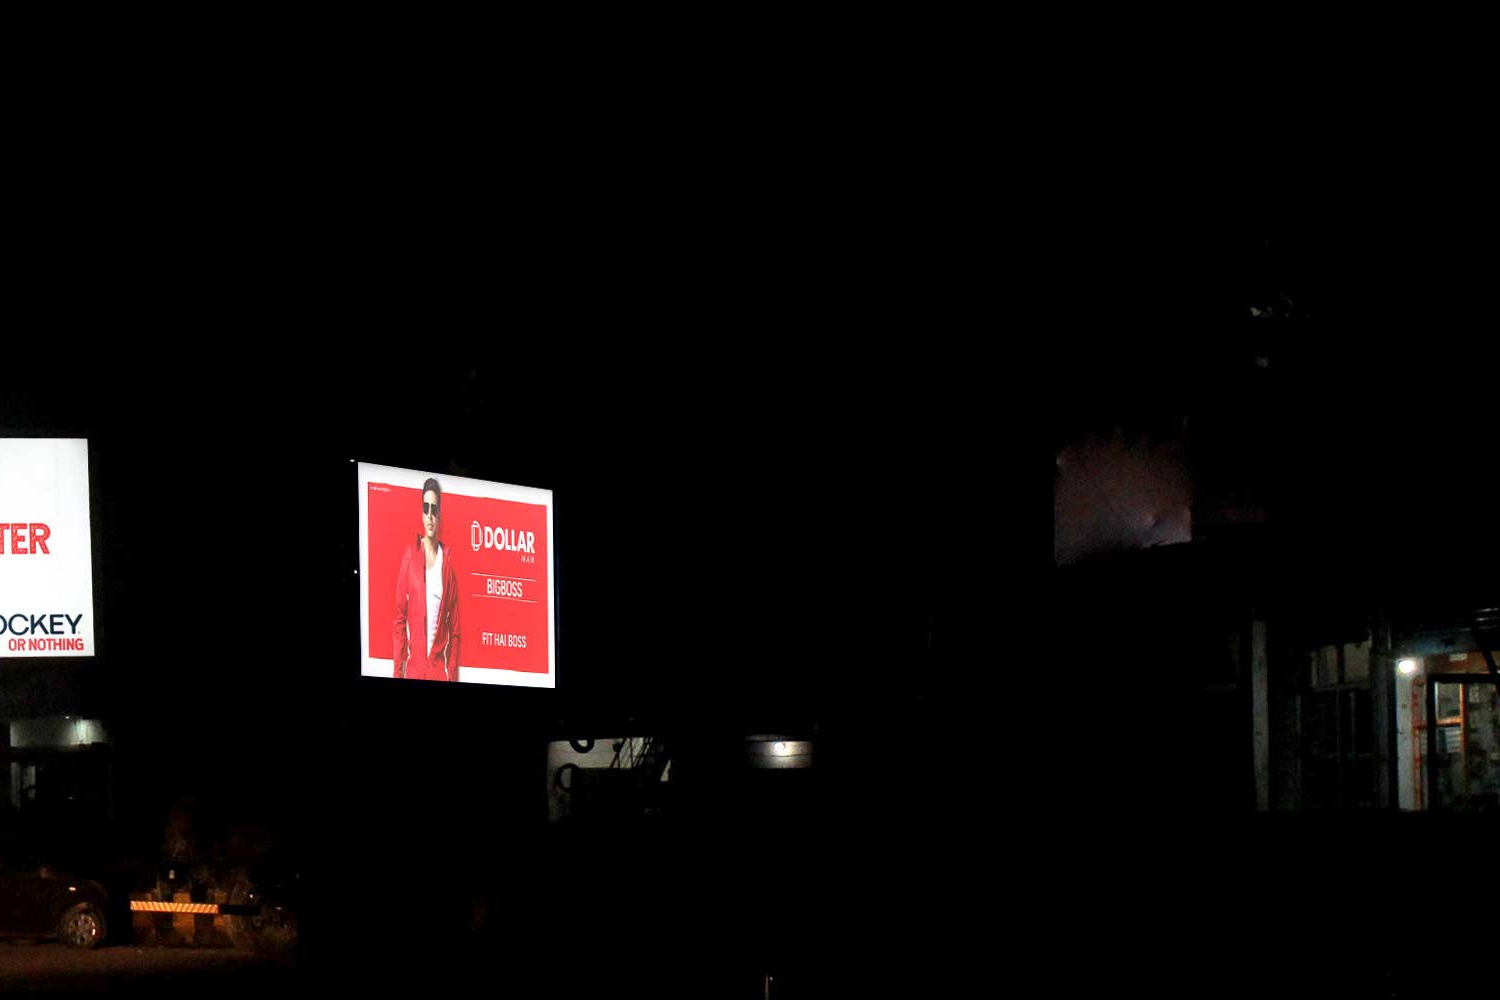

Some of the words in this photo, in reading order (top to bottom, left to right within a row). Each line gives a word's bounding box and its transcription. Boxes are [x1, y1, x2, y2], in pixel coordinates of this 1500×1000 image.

[484, 525, 536, 554] DOLLAR
[487, 578, 523, 598] BIGBOSS
[8, 638, 26, 651] OR
[28, 638, 85, 651] NOTHING
[482, 631, 493, 646] FIT
[494, 632, 507, 647] HAI
[508, 634, 527, 649] BOSS
